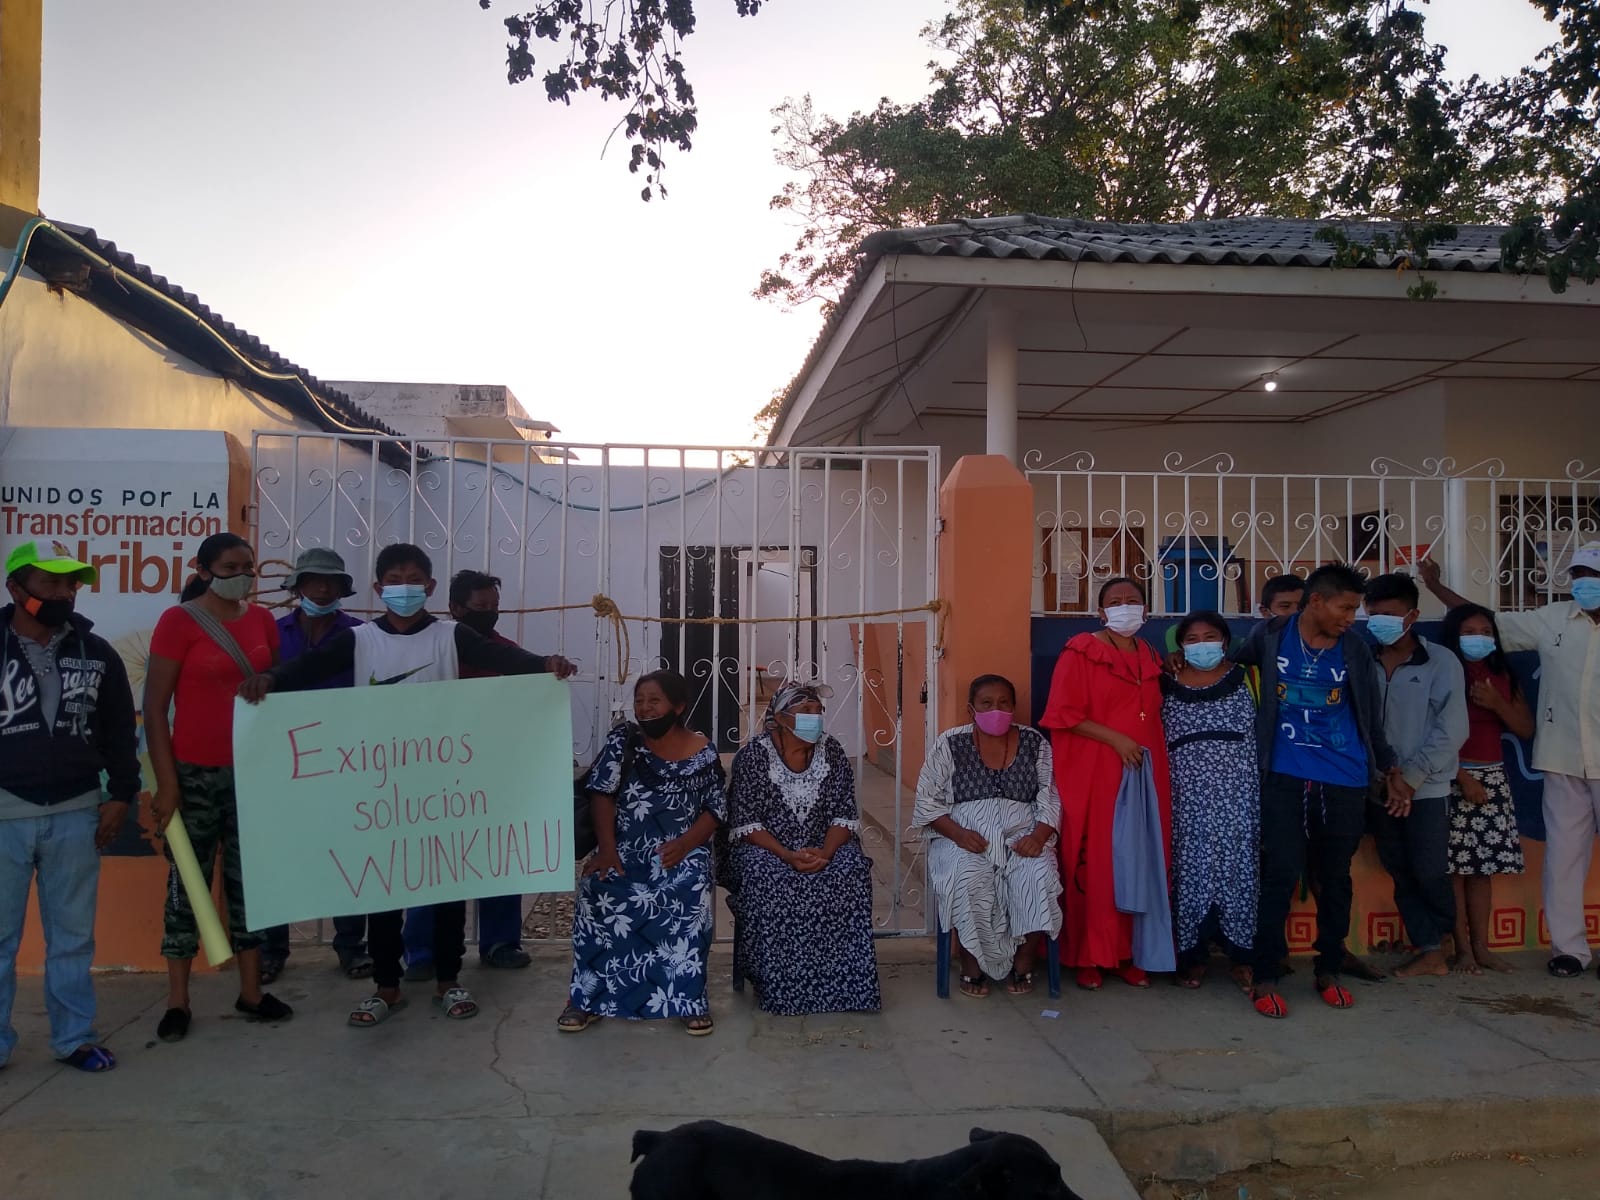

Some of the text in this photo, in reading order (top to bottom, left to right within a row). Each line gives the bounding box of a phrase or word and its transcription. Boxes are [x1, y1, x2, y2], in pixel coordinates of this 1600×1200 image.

[2, 486, 103, 505] UNIDOS
[193, 492, 220, 509] LA
[2, 506, 221, 536] Transformación
[288, 721, 474, 788] Exigimos
[354, 779, 488, 831] solución
[329, 819, 561, 898] WUINKUALU
